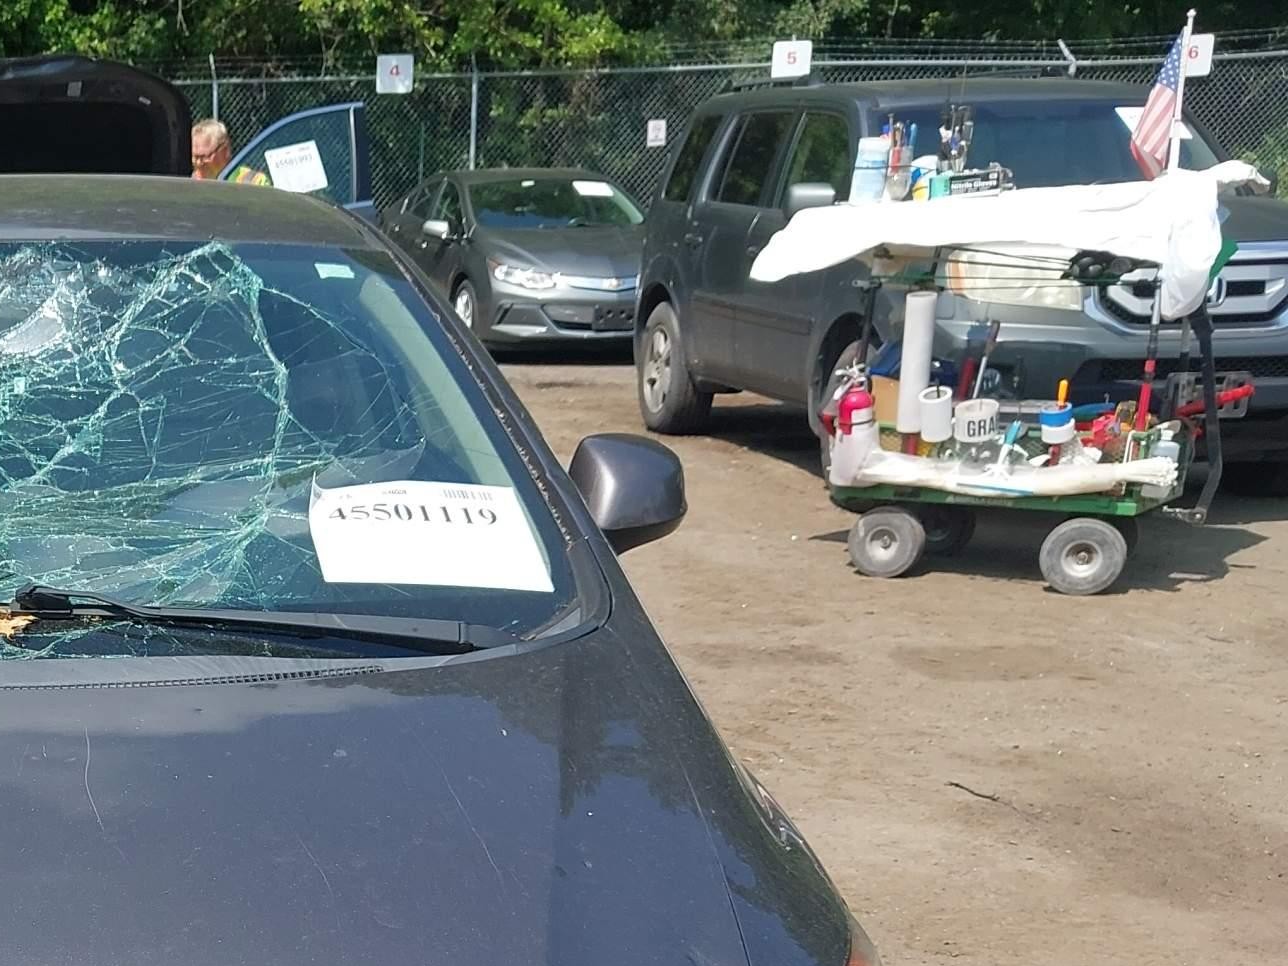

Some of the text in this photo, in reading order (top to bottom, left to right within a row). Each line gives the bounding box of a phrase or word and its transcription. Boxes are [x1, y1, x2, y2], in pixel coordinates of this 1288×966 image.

[787, 51, 797, 64] 5
[1188, 45, 1199, 59] 6
[389, 64, 400, 76] 4
[328, 503, 497, 524] 45501119
